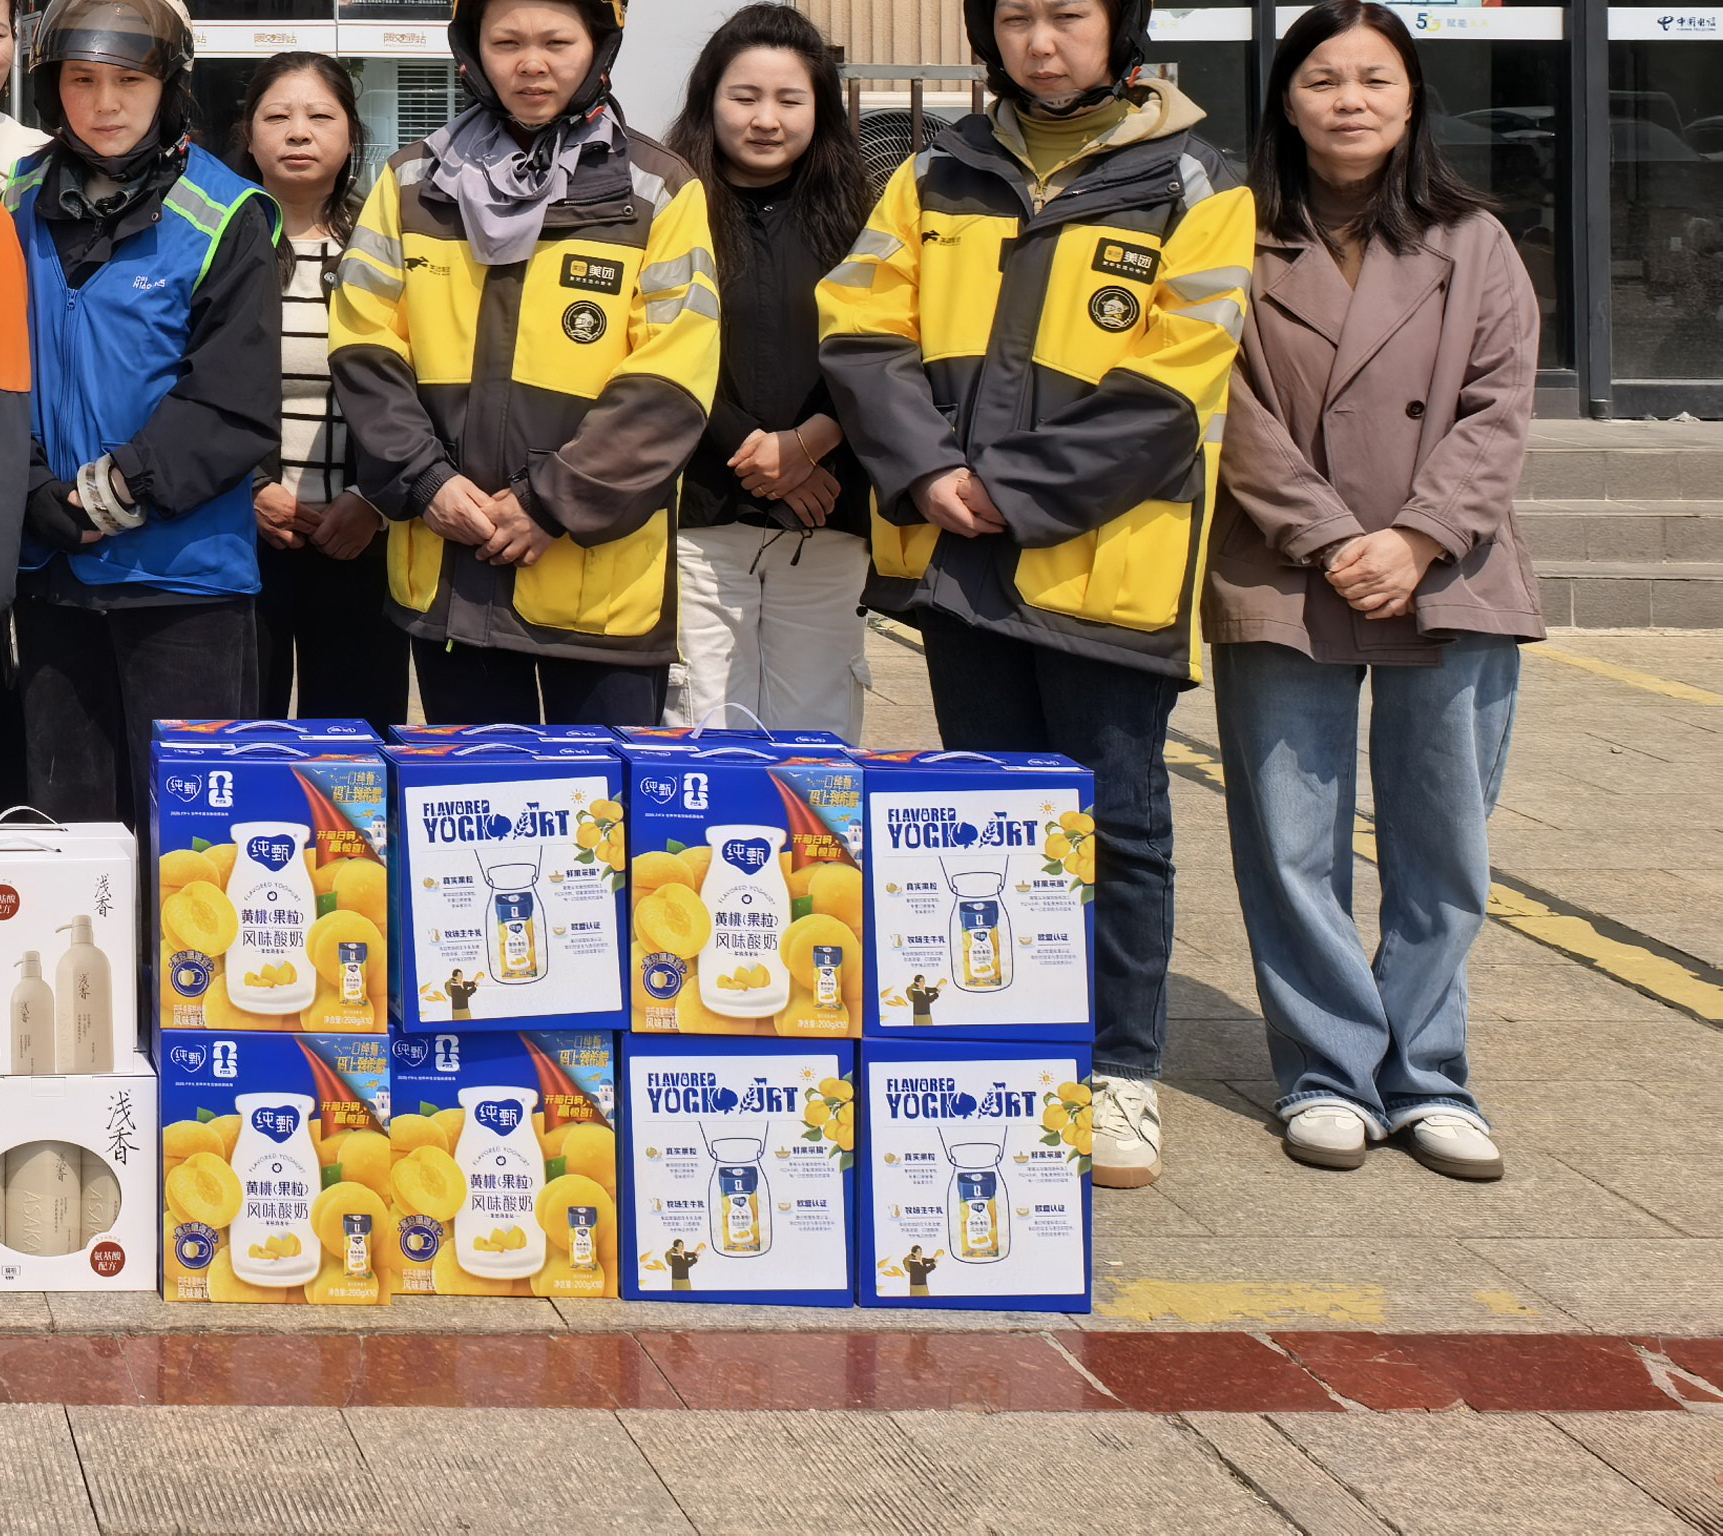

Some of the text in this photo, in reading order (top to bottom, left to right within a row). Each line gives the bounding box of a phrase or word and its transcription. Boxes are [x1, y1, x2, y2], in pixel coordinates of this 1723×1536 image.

[1123, 251, 1152, 268] 美团
[589, 264, 615, 280] 美团
[171, 779, 197, 794] 纯甄
[423, 800, 489, 816] FLAVORED
[888, 808, 956, 822] FLAVORED
[252, 840, 290, 861] 纯甄
[727, 843, 765, 865] 纯甄
[94, 873, 112, 918] 浅香
[242, 909, 303, 924] 黄桃(果粒)
[715, 912, 778, 927] 黄桃(果粒)
[242, 930, 303, 947] 风味酸奶
[716, 933, 777, 949] 风味酸奶
[397, 1043, 423, 1058] 纯甄
[648, 1073, 716, 1087] FLAVORED
[887, 1078, 955, 1092] FLAVORED
[256, 1111, 293, 1133] 纯甄
[479, 1104, 517, 1126] 纯甄
[106, 1091, 140, 1165] 浅香
[246, 1181, 308, 1197] 黄桃(果粒)
[470, 1174, 532, 1190] 黄桃(果粒)
[247, 1202, 308, 1219] 风味酸奶
[472, 1195, 532, 1211] 风味酸奶
[94, 1252, 121, 1261] 氨基酸
[98, 1262, 116, 1272] 配方
